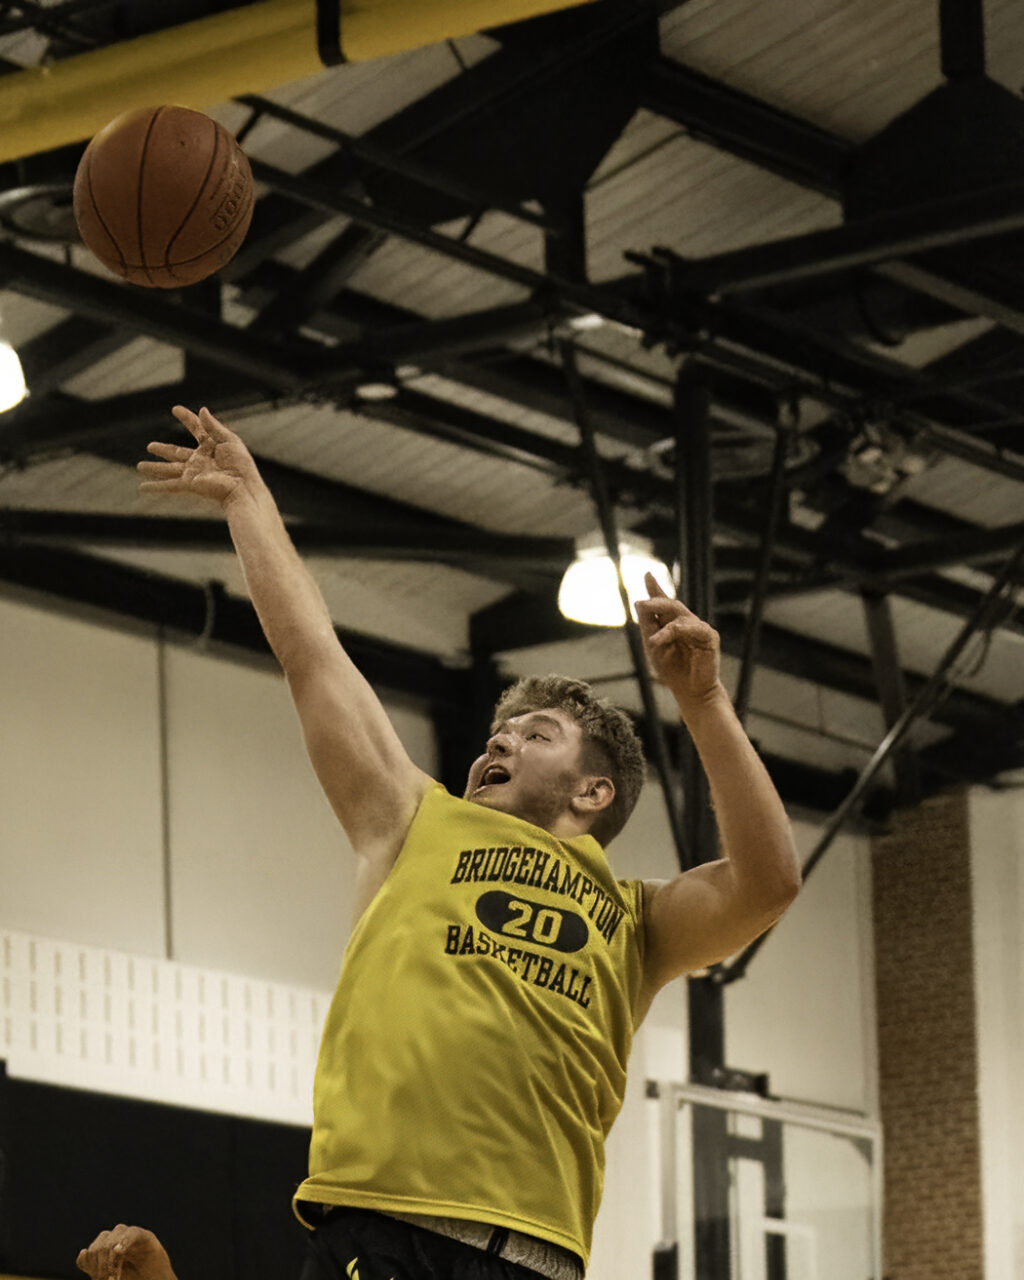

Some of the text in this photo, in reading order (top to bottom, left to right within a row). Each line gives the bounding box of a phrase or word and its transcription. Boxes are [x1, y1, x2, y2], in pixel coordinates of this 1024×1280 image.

[450, 846, 625, 945] BRIDGEHAMPTON
[502, 901, 562, 945] 20
[444, 926, 591, 1008] BASKETBALL
